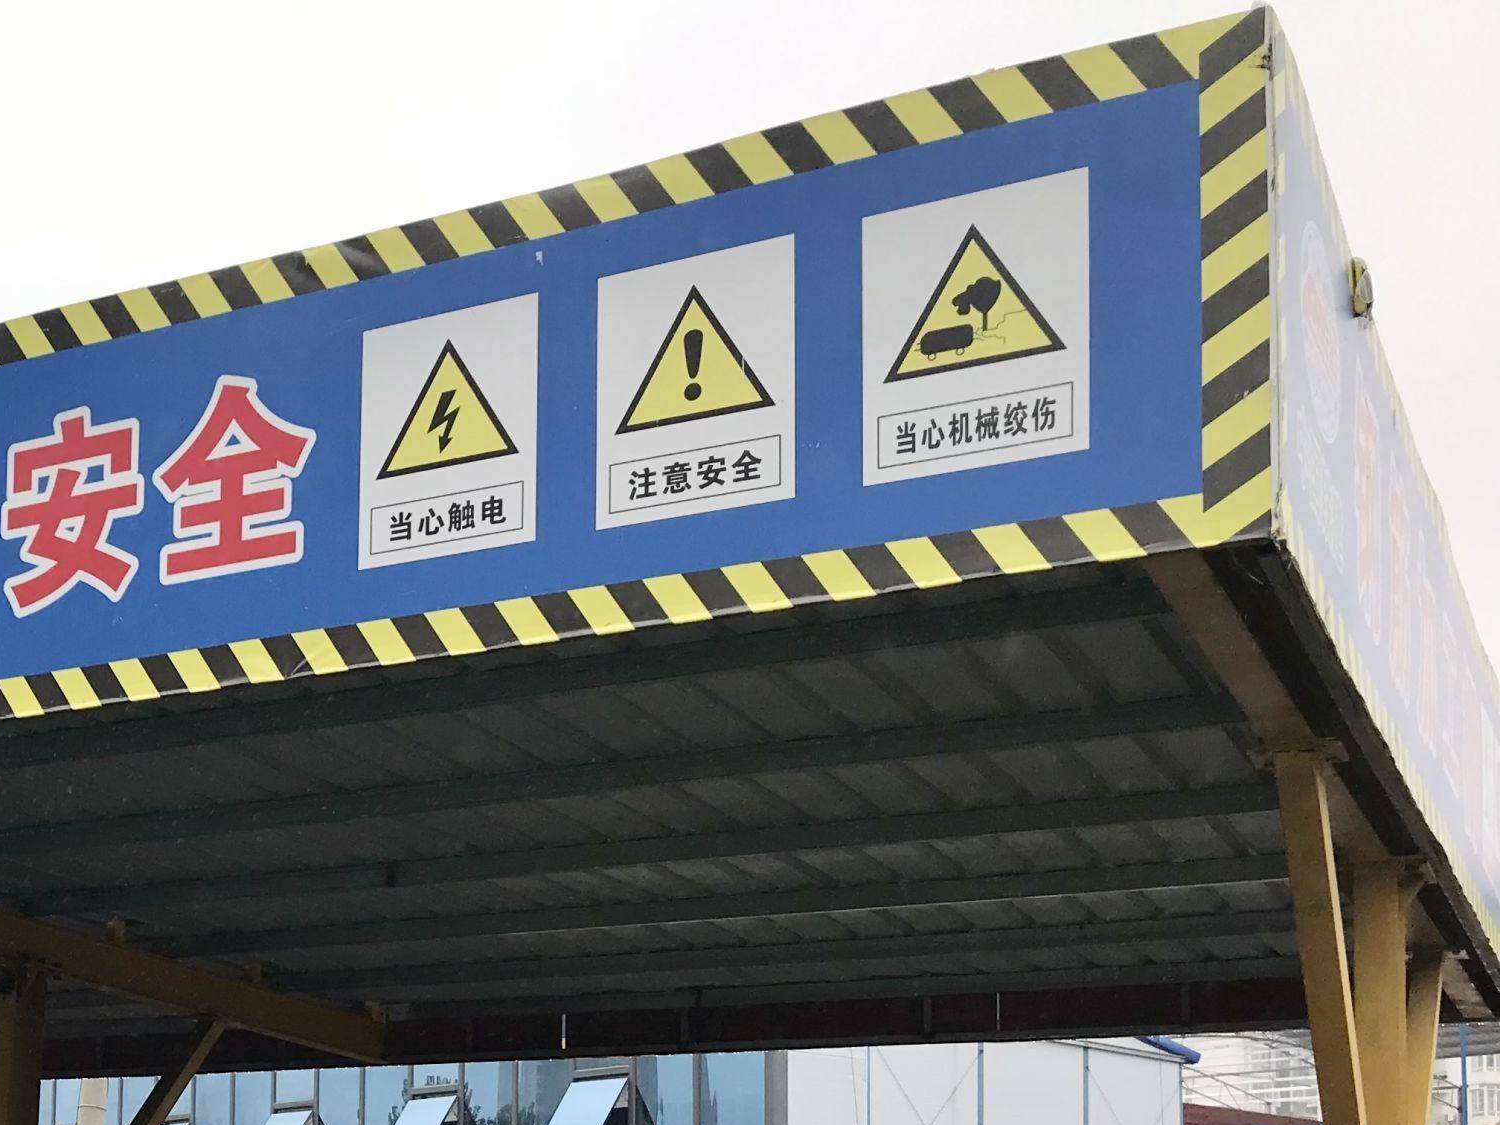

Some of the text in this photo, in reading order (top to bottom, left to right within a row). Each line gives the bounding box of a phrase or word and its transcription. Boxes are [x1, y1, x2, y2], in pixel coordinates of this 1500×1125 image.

[894, 395, 1056, 455] 当心机械绞伤
[627, 451, 763, 500] 注意安全
[389, 495, 507, 541] 当心触电
